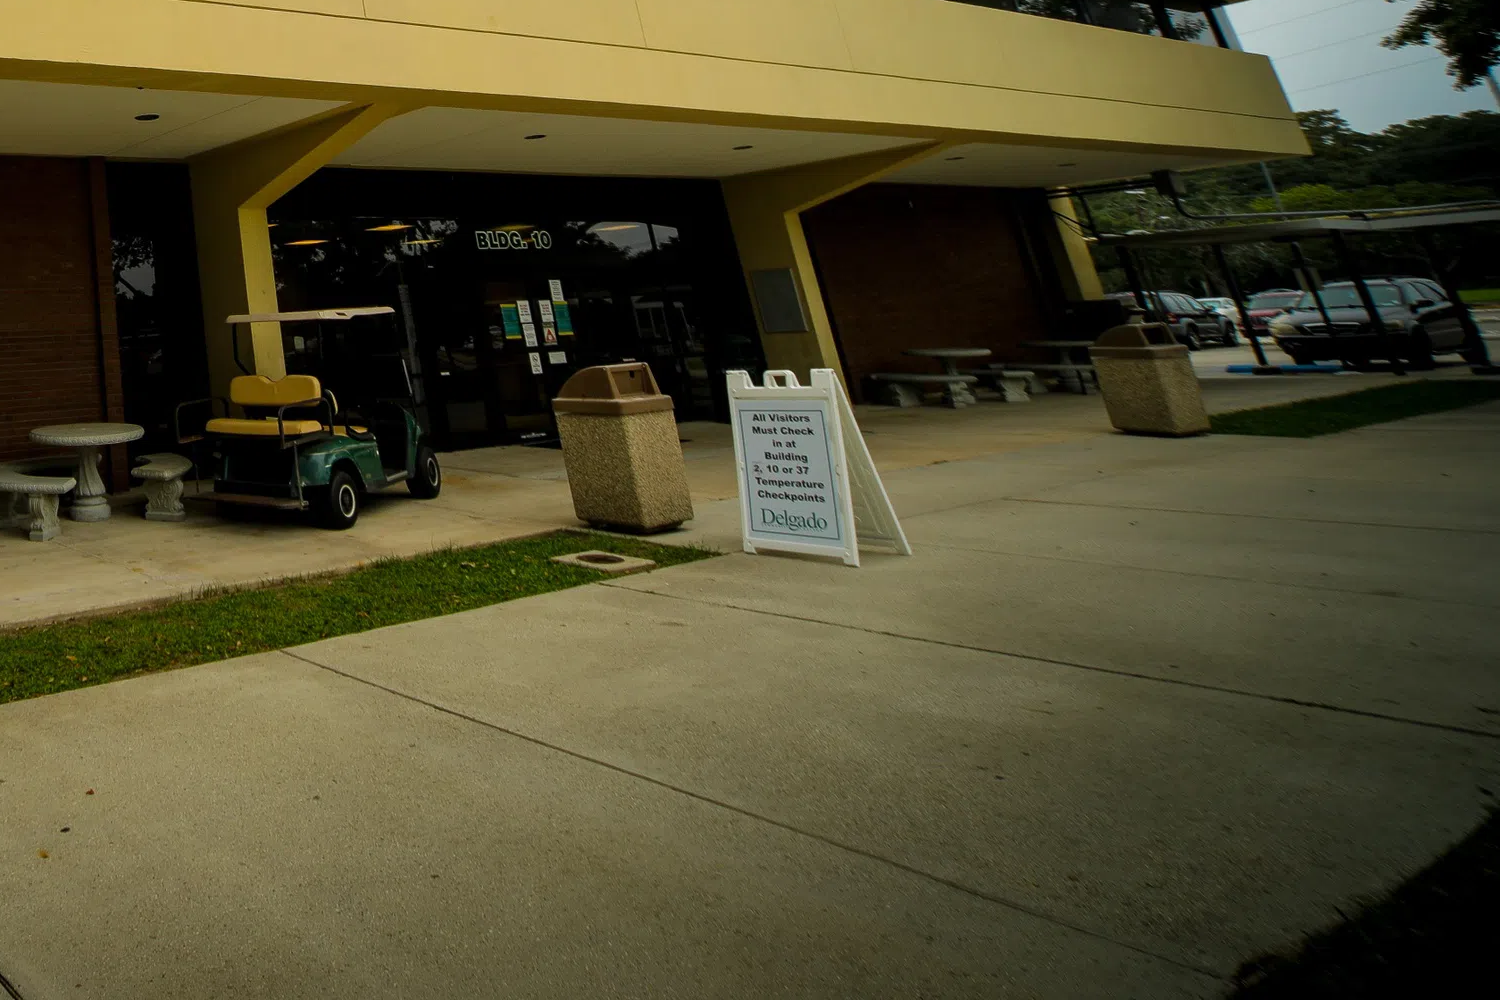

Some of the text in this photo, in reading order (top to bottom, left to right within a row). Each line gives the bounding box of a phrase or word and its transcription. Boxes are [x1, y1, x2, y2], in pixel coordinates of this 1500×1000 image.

[475, 230, 552, 250] BLDG. 10
[752, 413, 810, 423] All Visitors
[752, 426, 814, 436] Must Check
[772, 439, 797, 449] in at
[764, 451, 808, 463] Building
[753, 465, 763, 474] 2,
[766, 465, 779, 474] 10
[795, 465, 809, 475] 37
[755, 476, 825, 490] Temperature
[757, 490, 826, 503] Checkpoints
[760, 507, 828, 531] Delgado
